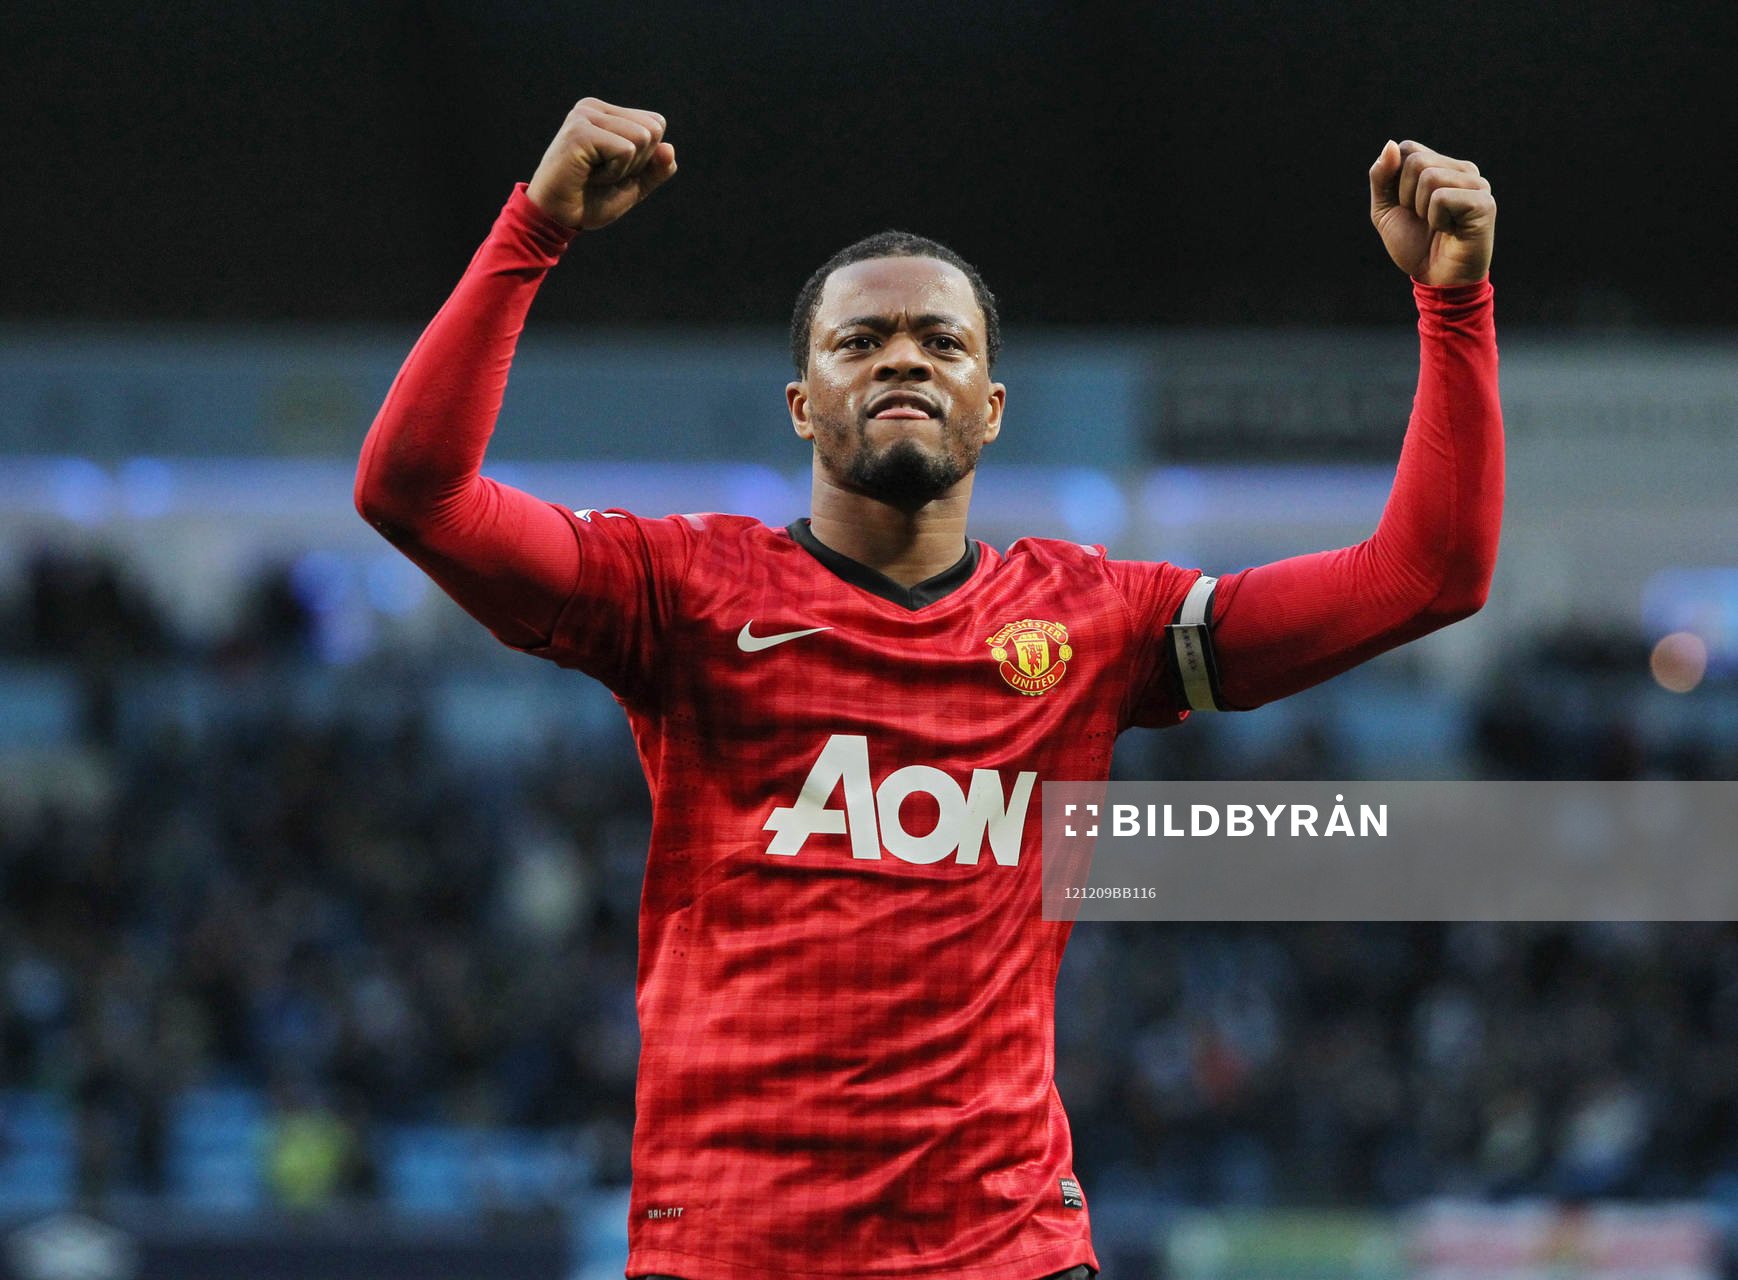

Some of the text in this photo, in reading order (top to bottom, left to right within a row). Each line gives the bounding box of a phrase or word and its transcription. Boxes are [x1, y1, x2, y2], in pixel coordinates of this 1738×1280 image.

[1011, 673, 1055, 689] UNITED
[762, 734, 1038, 867] AON
[647, 1207, 684, 1219] DRI-FIT
